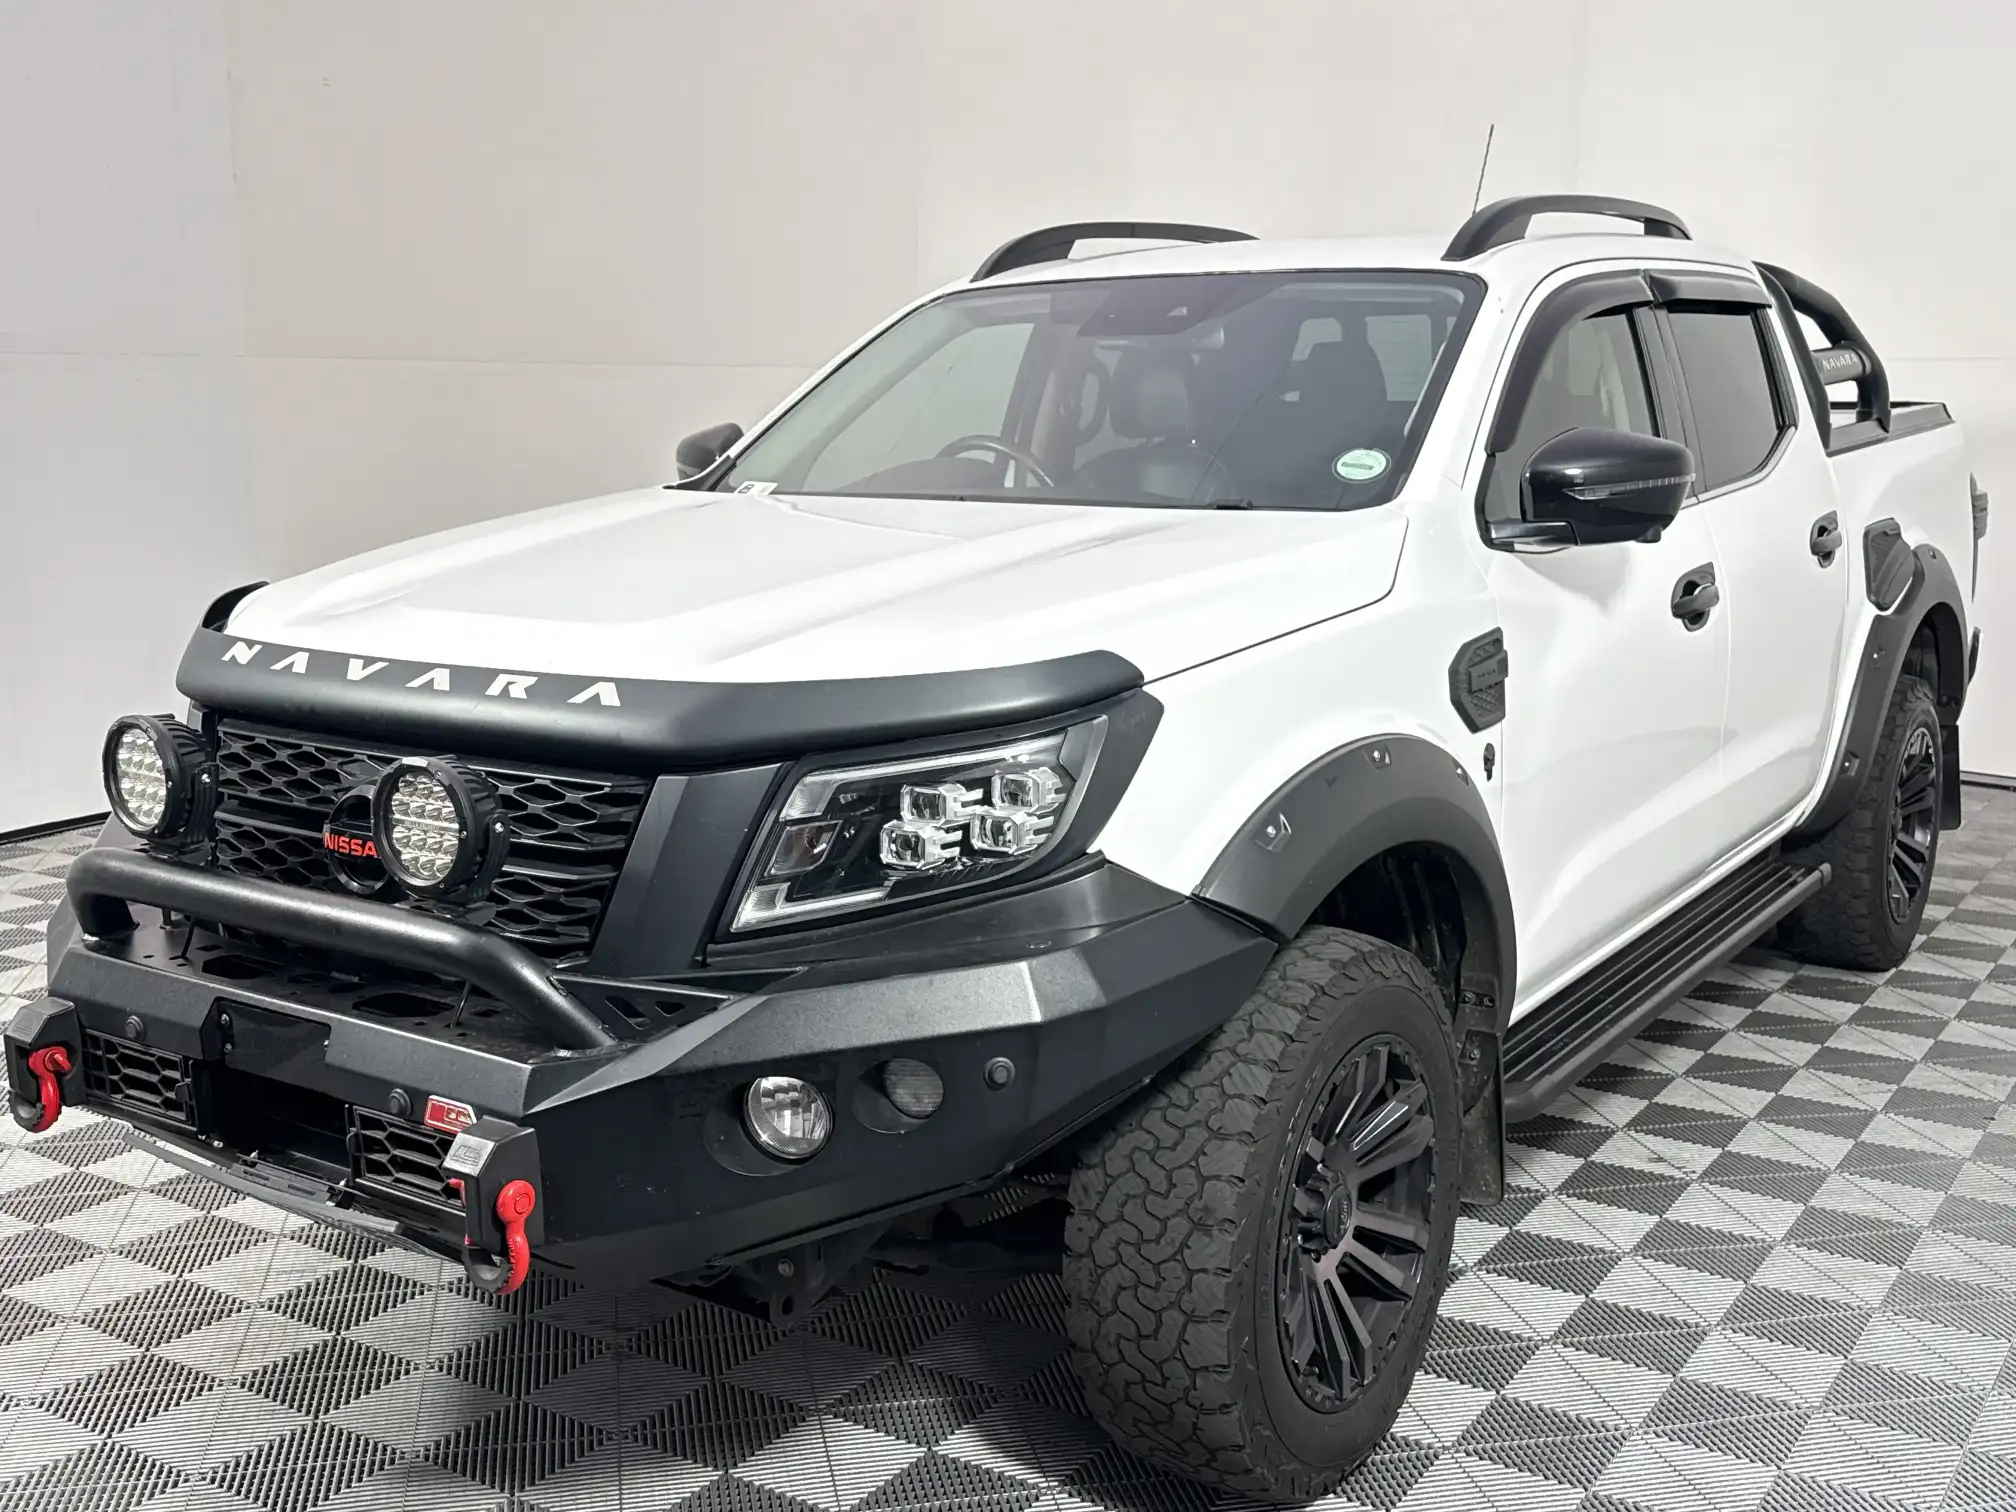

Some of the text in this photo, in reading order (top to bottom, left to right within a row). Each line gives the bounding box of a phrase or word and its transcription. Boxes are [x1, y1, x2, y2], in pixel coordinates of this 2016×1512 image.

[1822, 353, 1858, 371] NAVARA
[221, 641, 622, 707] NAVARA
[323, 832, 381, 859] NISSA
